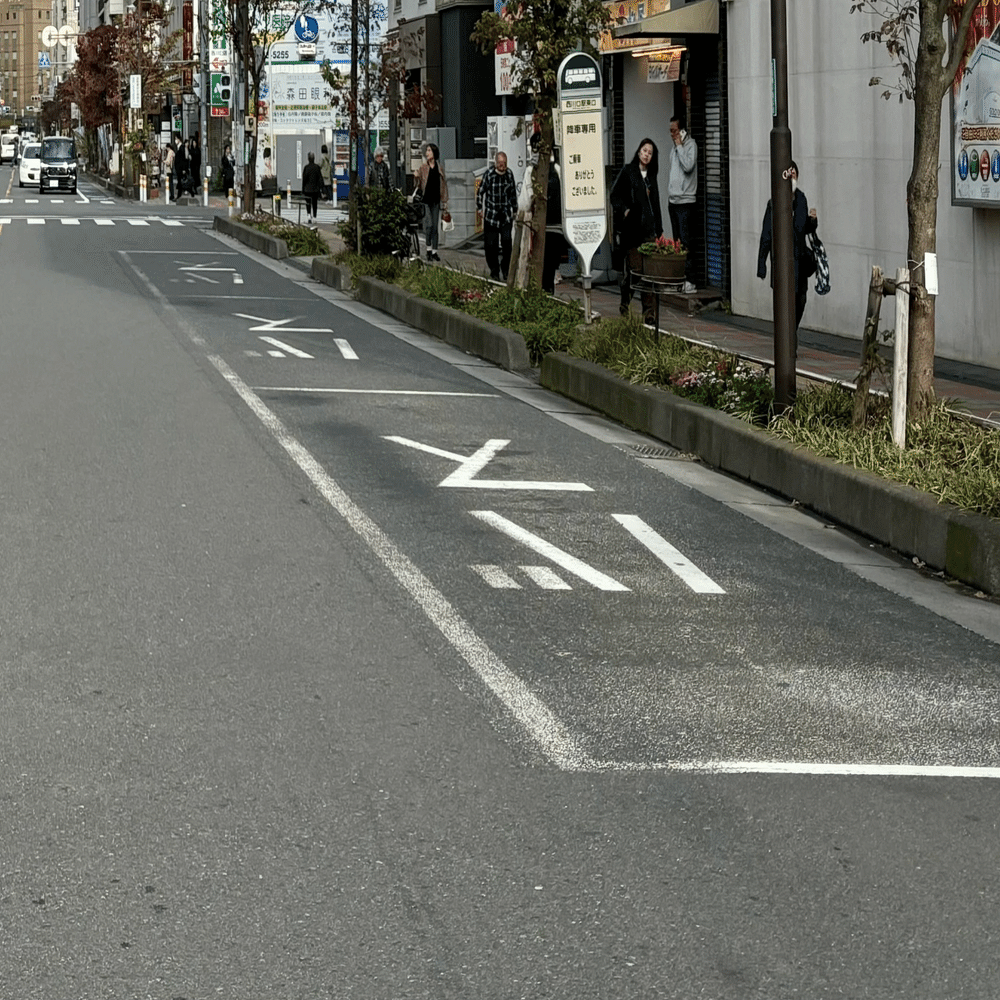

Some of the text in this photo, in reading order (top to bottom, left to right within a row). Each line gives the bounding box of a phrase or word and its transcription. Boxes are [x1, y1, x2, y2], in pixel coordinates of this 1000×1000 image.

[566, 100, 597, 108] 西川口駅東口
[566, 123, 597, 135] 降車専用
[574, 170, 595, 180] ありがとう
